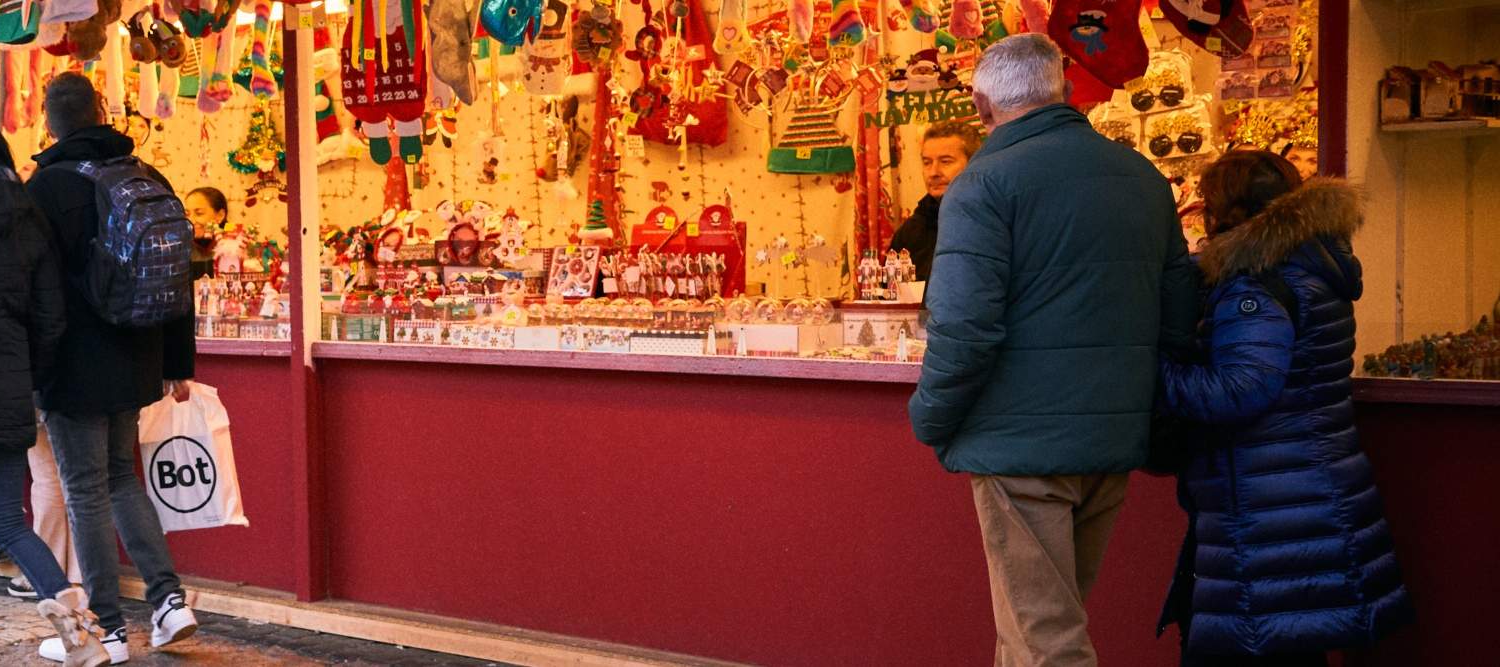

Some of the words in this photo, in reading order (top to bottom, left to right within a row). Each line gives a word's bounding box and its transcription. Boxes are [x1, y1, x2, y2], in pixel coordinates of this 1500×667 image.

[394, 42, 402, 52] 5
[343, 64, 350, 73] 7
[395, 59, 403, 68] 11
[343, 80, 352, 89] 13
[355, 79, 365, 88] 14
[395, 74, 403, 84] 17
[357, 94, 368, 104] 20
[382, 91, 393, 101] 22
[394, 90, 406, 100] 23
[407, 89, 419, 99] 24
[889, 88, 950, 108] FELIZ
[864, 99, 977, 128] NAVIDAD
[156, 457, 212, 489] Bot
